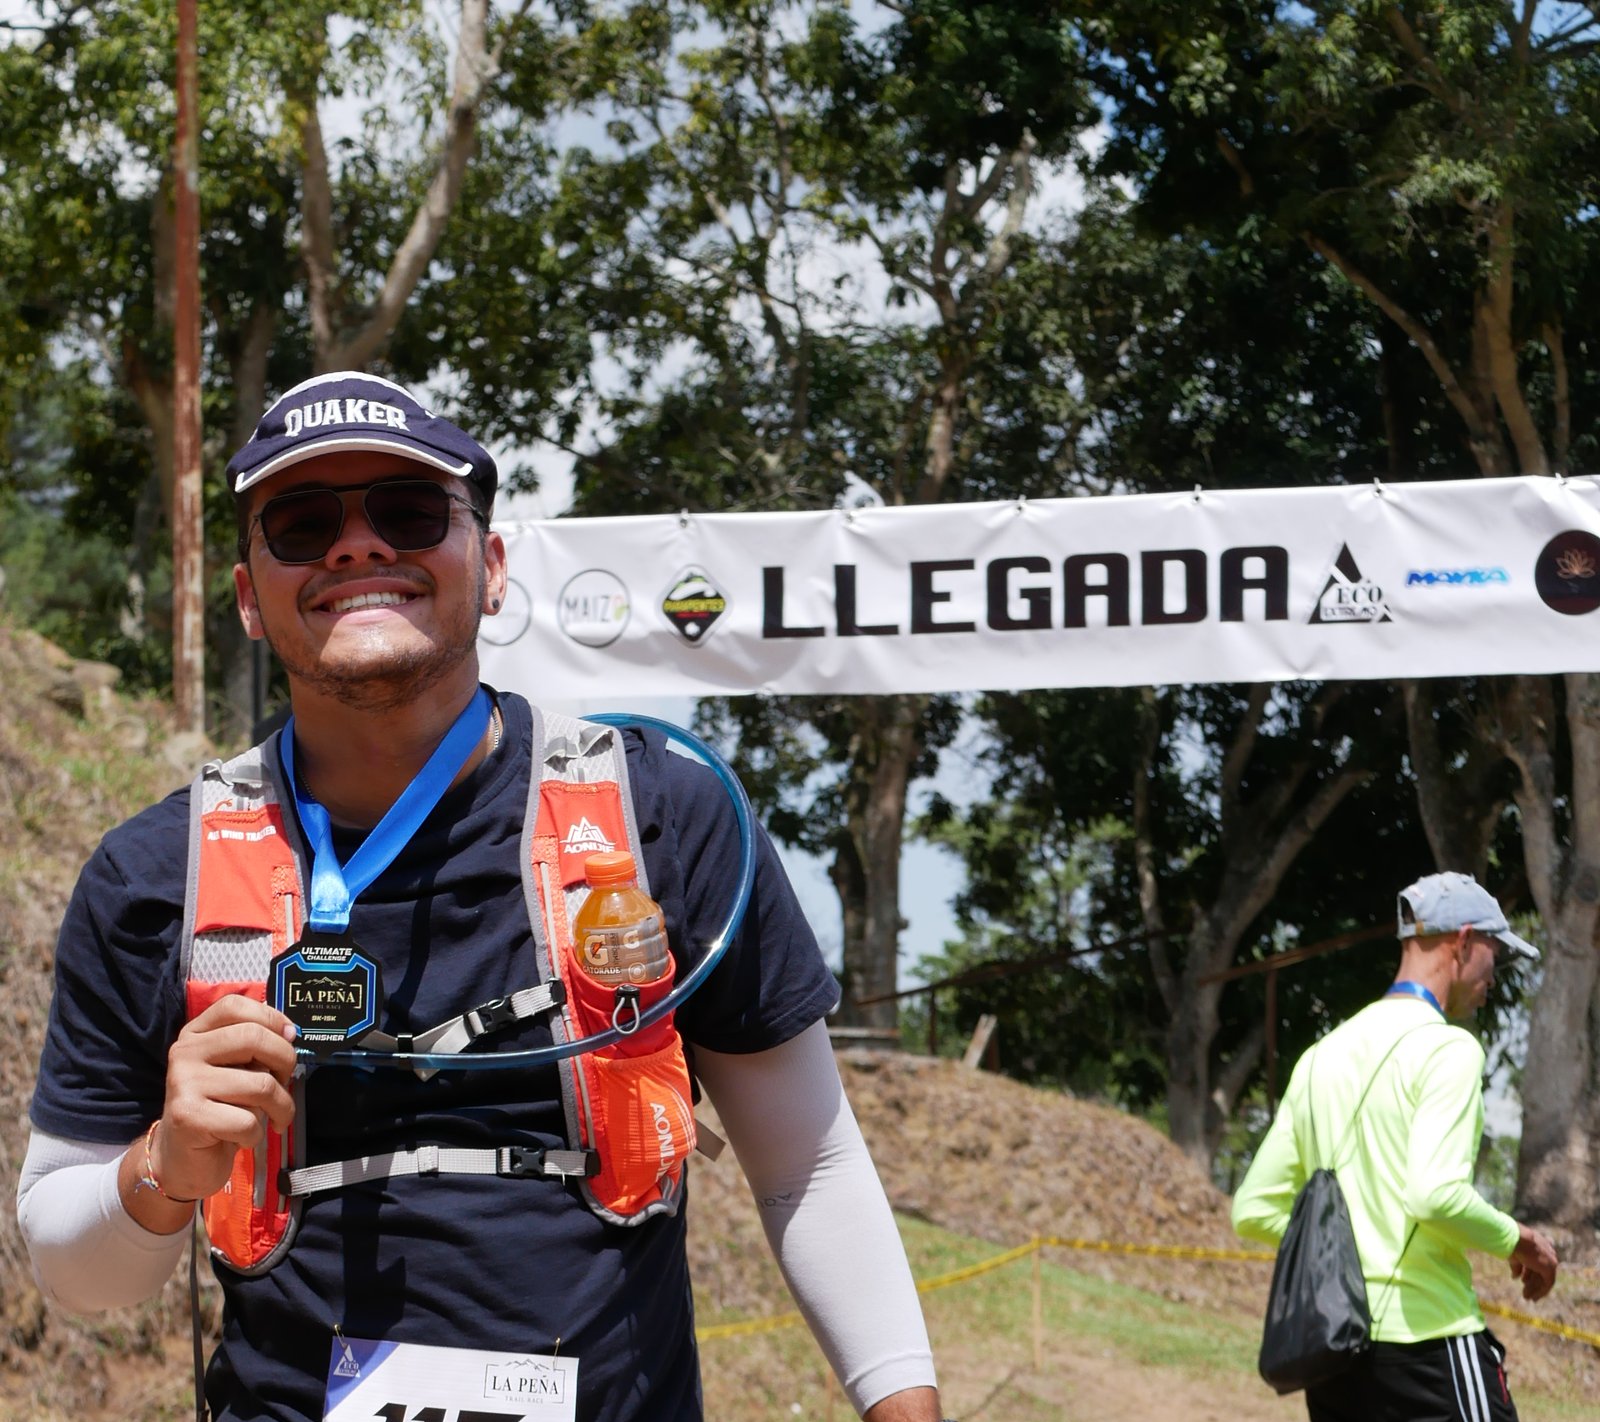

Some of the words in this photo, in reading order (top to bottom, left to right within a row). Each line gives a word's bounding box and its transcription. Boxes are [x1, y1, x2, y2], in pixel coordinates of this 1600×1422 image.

[284, 398, 411, 438] QUAKER
[762, 545, 1289, 638] LLEGADA
[1335, 586, 1383, 605] ECO
[563, 842, 615, 853] AONIJIE
[301, 947, 352, 956] ULTIMATE
[584, 934, 609, 966] G
[582, 965, 621, 975] GATORADE
[295, 990, 313, 1002] LA
[317, 988, 355, 1003] PEÑA
[492, 1375, 512, 1391] LA
[518, 1374, 559, 1395] PEÑA
